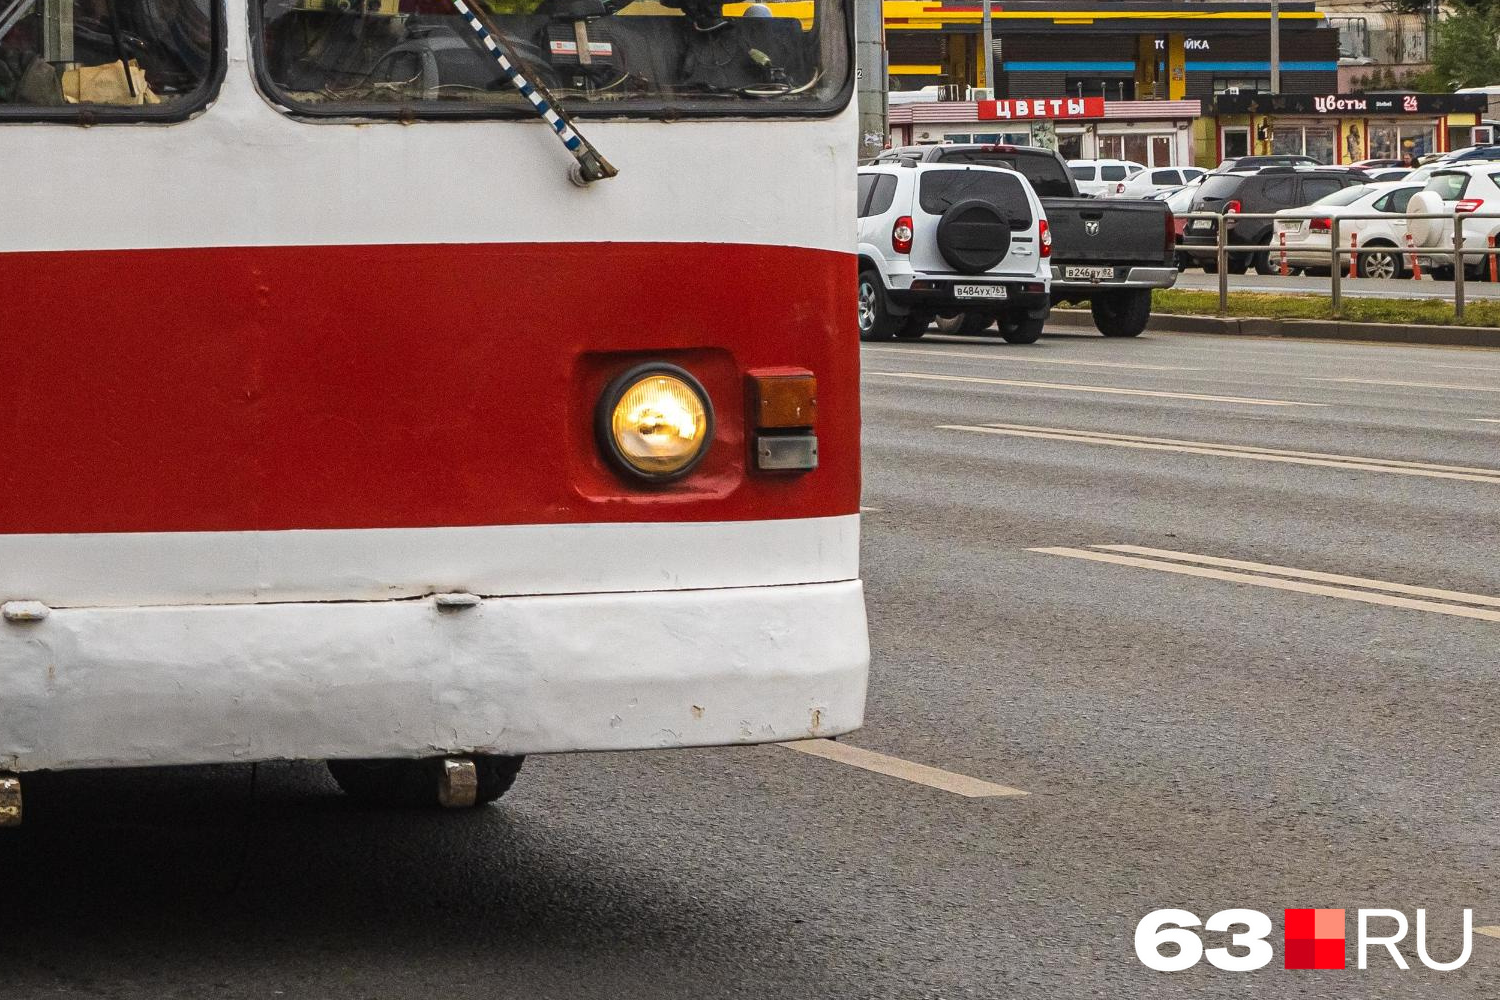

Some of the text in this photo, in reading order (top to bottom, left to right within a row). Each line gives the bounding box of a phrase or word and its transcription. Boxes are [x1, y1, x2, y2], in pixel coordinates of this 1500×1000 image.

[1184, 38, 1210, 50] ЙКА
[1404, 96, 1418, 107] 24
[996, 99, 1085, 118] ЦВЕТЫ
